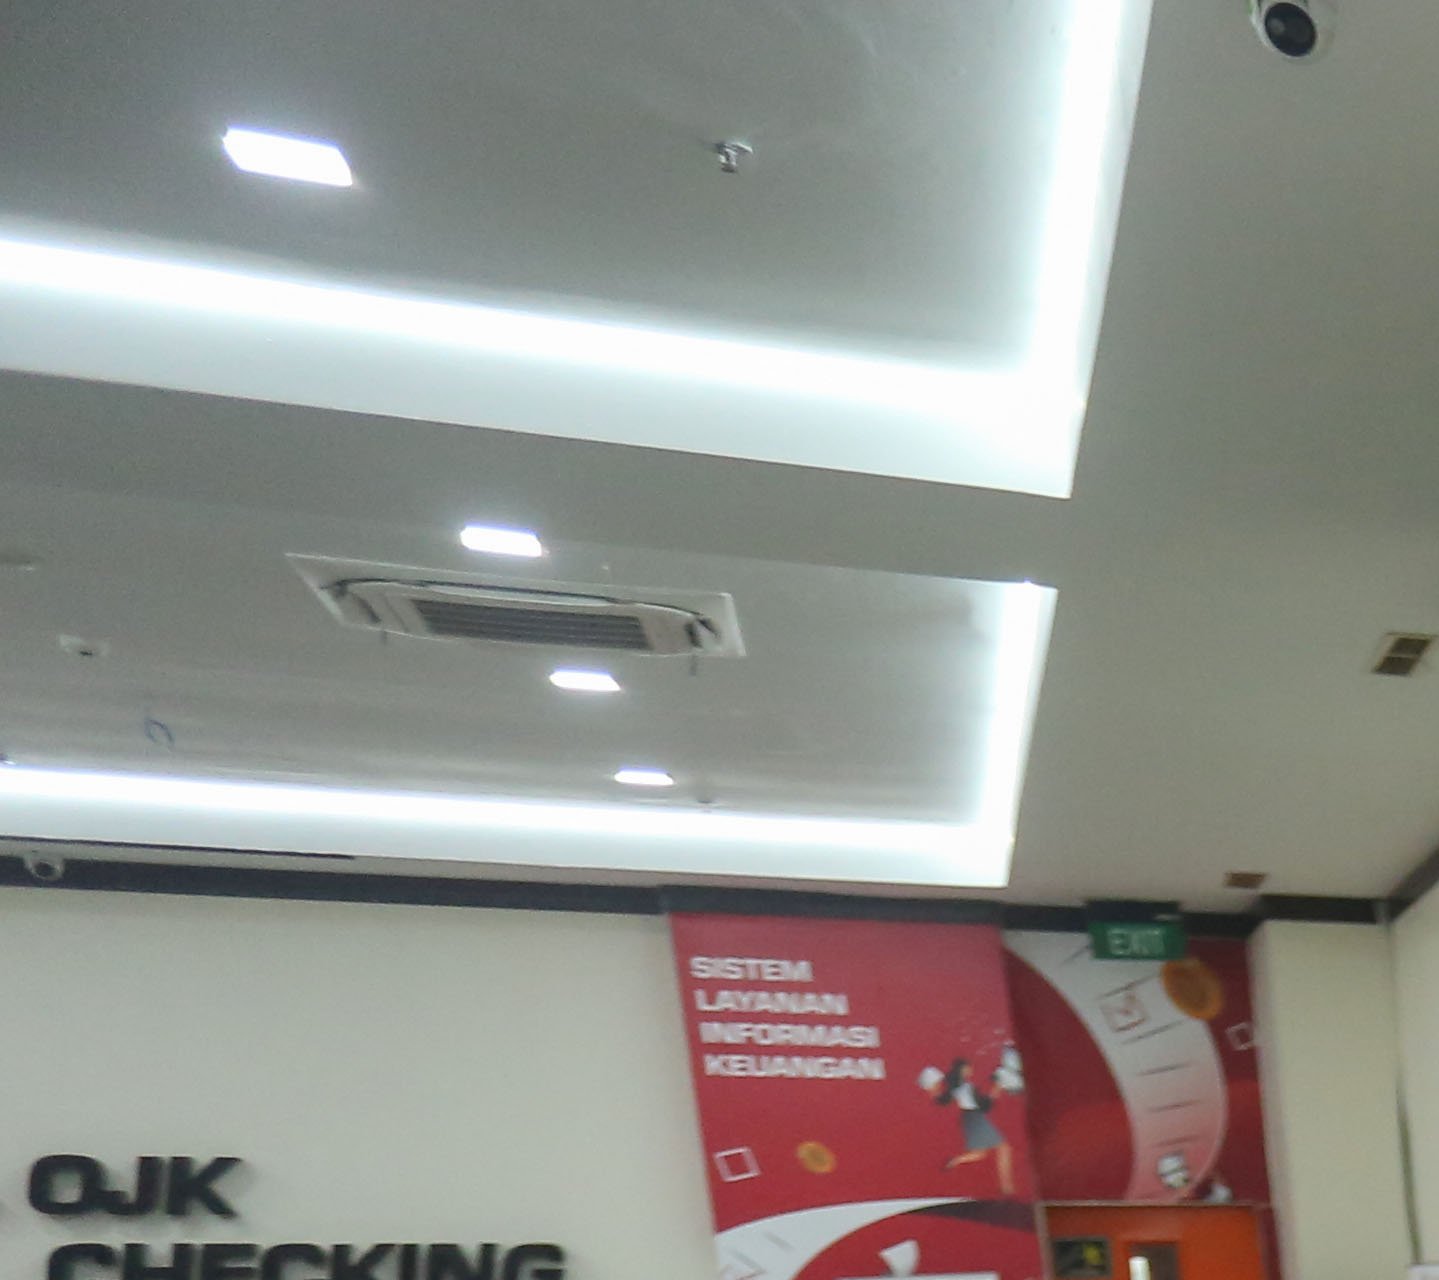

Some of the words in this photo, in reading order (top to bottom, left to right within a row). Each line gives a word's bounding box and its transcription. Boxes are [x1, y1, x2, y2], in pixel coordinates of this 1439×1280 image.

[690, 957, 814, 982] SISTEM
[694, 989, 848, 1015] LAYANAN
[700, 1022, 880, 1048] INFORMASI
[705, 1054, 886, 1080] KEUANGAN
[28, 1153, 242, 1218] OJK
